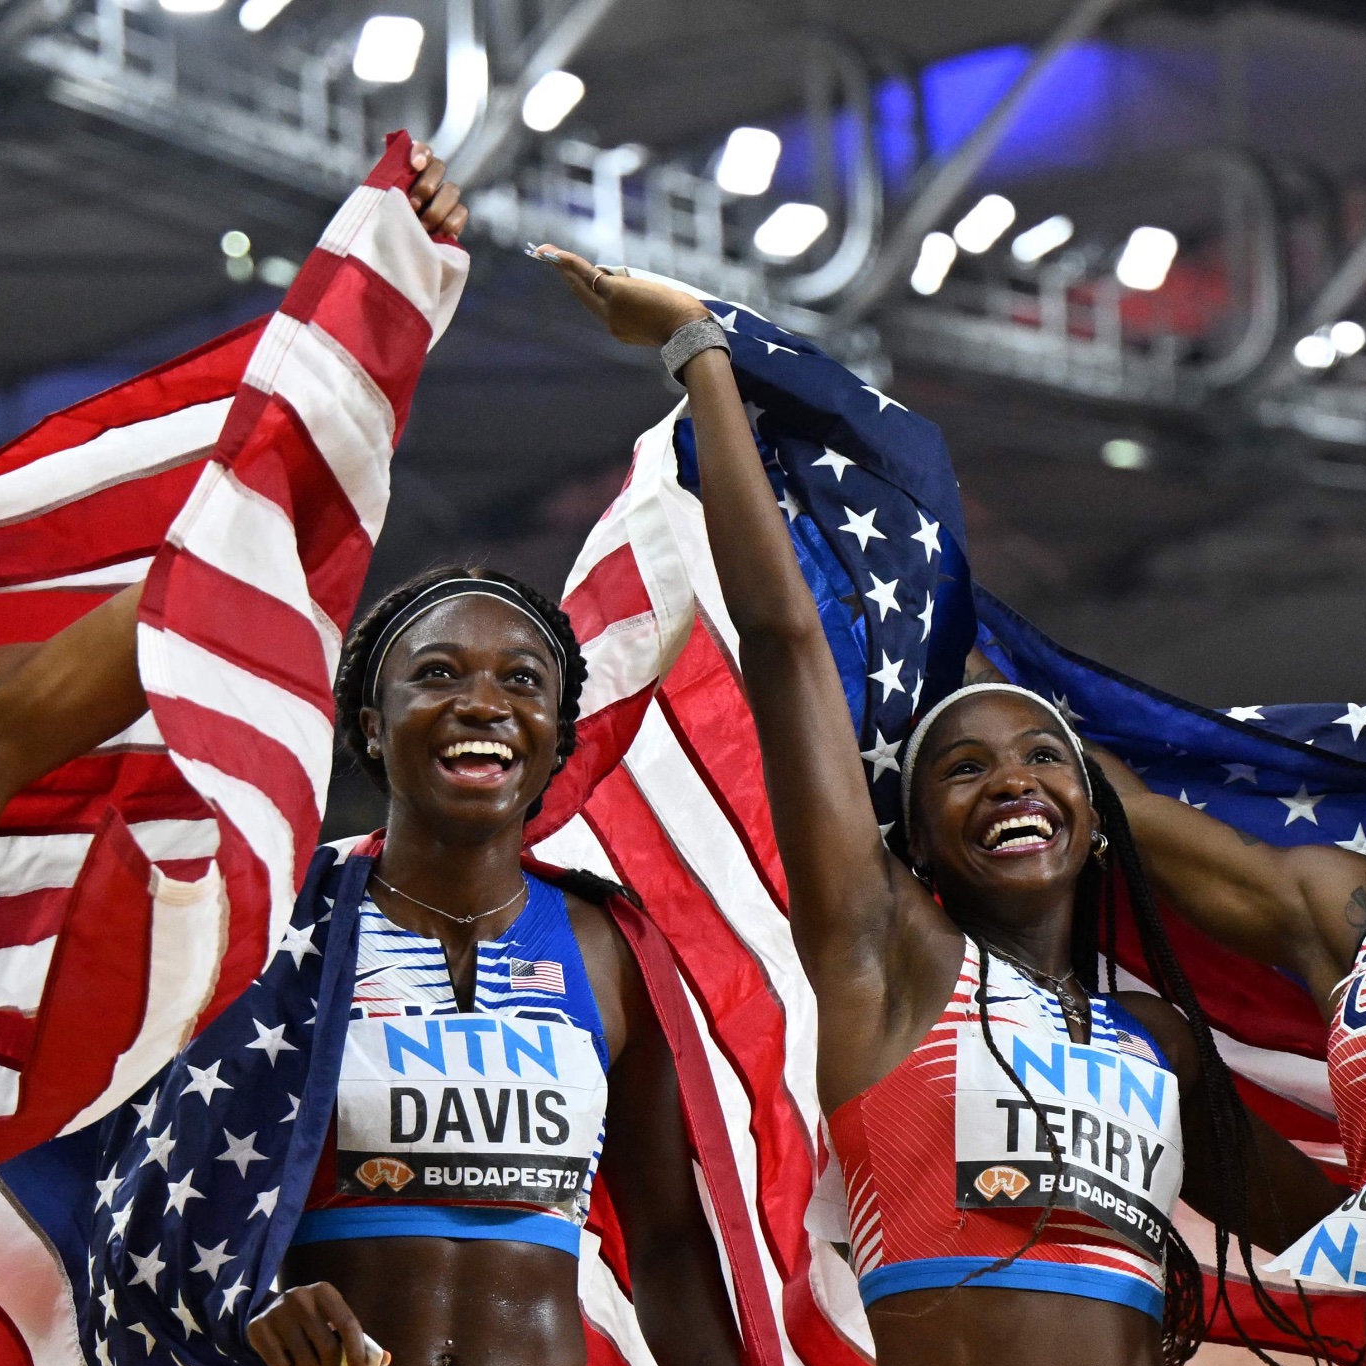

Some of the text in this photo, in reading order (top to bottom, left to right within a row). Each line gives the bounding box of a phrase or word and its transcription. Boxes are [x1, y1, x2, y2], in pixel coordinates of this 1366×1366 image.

[382, 1018, 559, 1081] NTN
[1012, 1033, 1165, 1130] NTN
[389, 1086, 570, 1147] DAVIS
[996, 1098, 1165, 1193] TERRY
[424, 1166, 564, 1189] BUDAPEST
[1039, 1174, 1162, 1243] BUDAPEST 23
